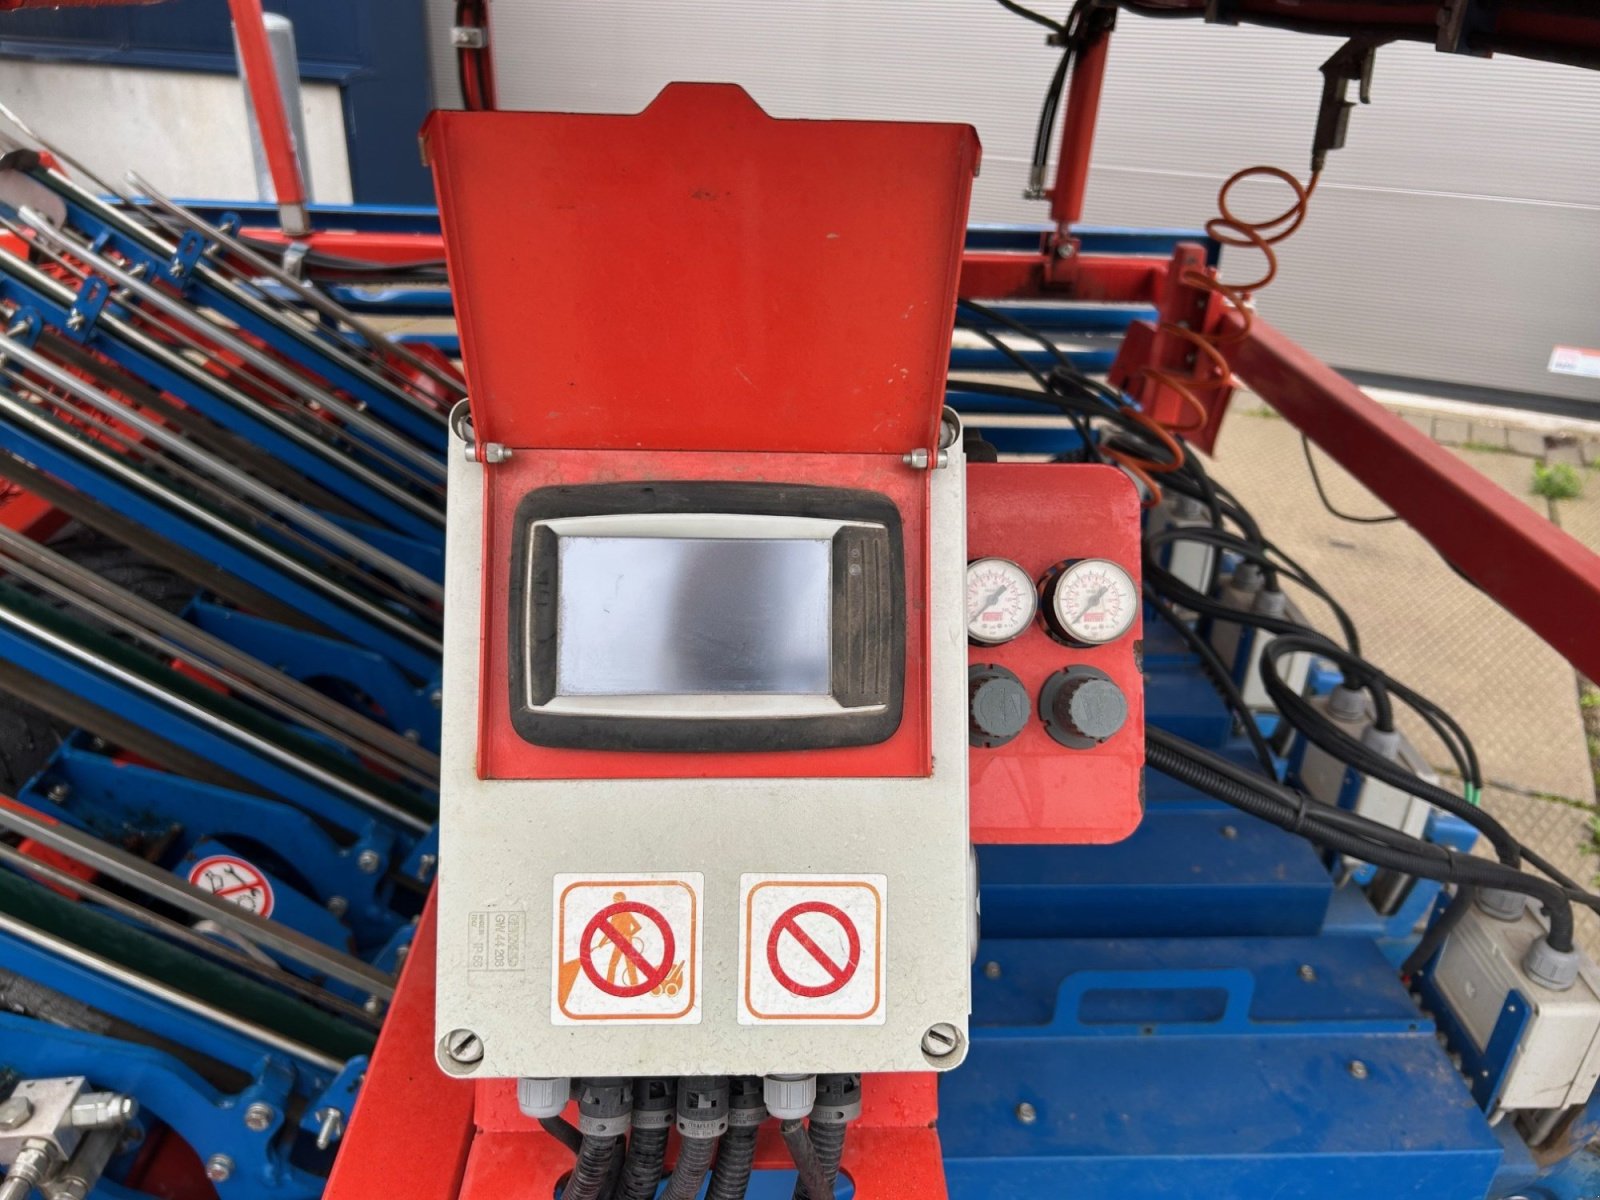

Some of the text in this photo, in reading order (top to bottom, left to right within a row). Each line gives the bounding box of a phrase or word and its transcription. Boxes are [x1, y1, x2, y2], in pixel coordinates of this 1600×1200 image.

[494, 914, 506, 968] GW 44 208
